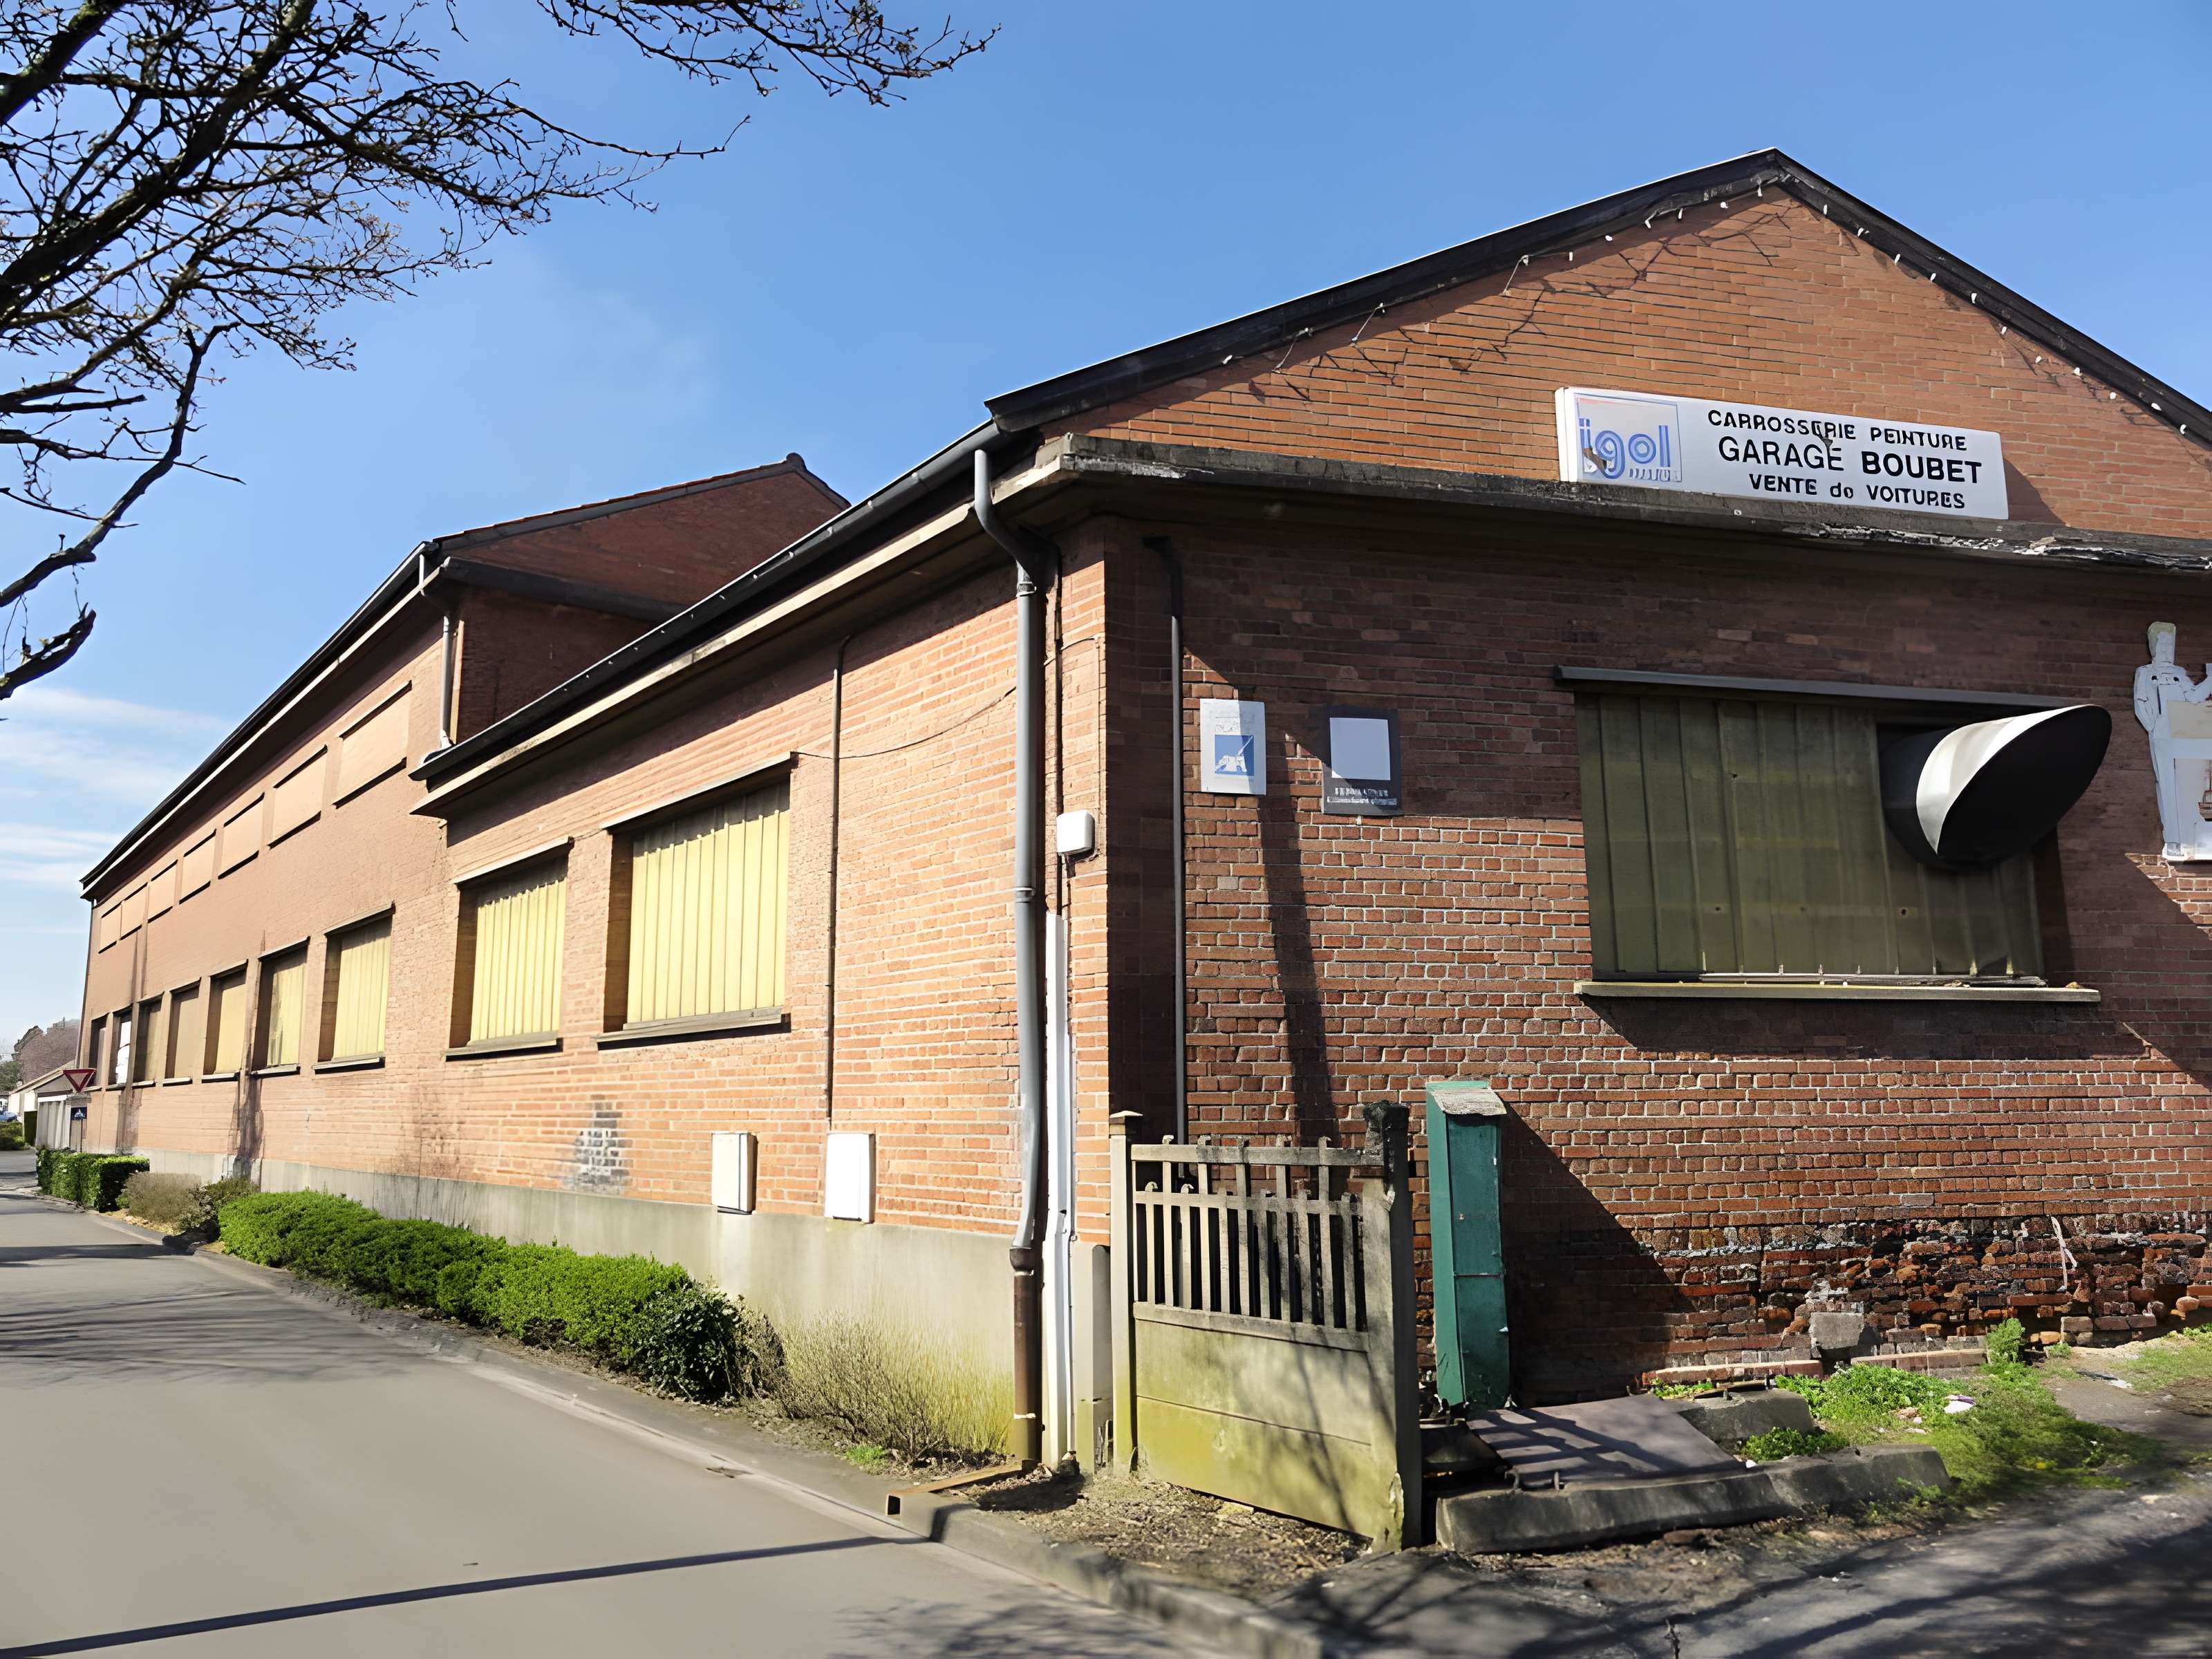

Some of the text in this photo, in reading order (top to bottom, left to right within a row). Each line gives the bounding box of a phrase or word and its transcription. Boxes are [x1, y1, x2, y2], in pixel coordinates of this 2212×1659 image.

[1579, 418, 1671, 479] igol
[1708, 409, 1967, 451] CARROSSERIE PEINTURE
[1718, 435, 1982, 484] GARAGE BOUBET
[1749, 474, 1817, 495] VENTE
[1866, 485, 1965, 509] VOITURES
